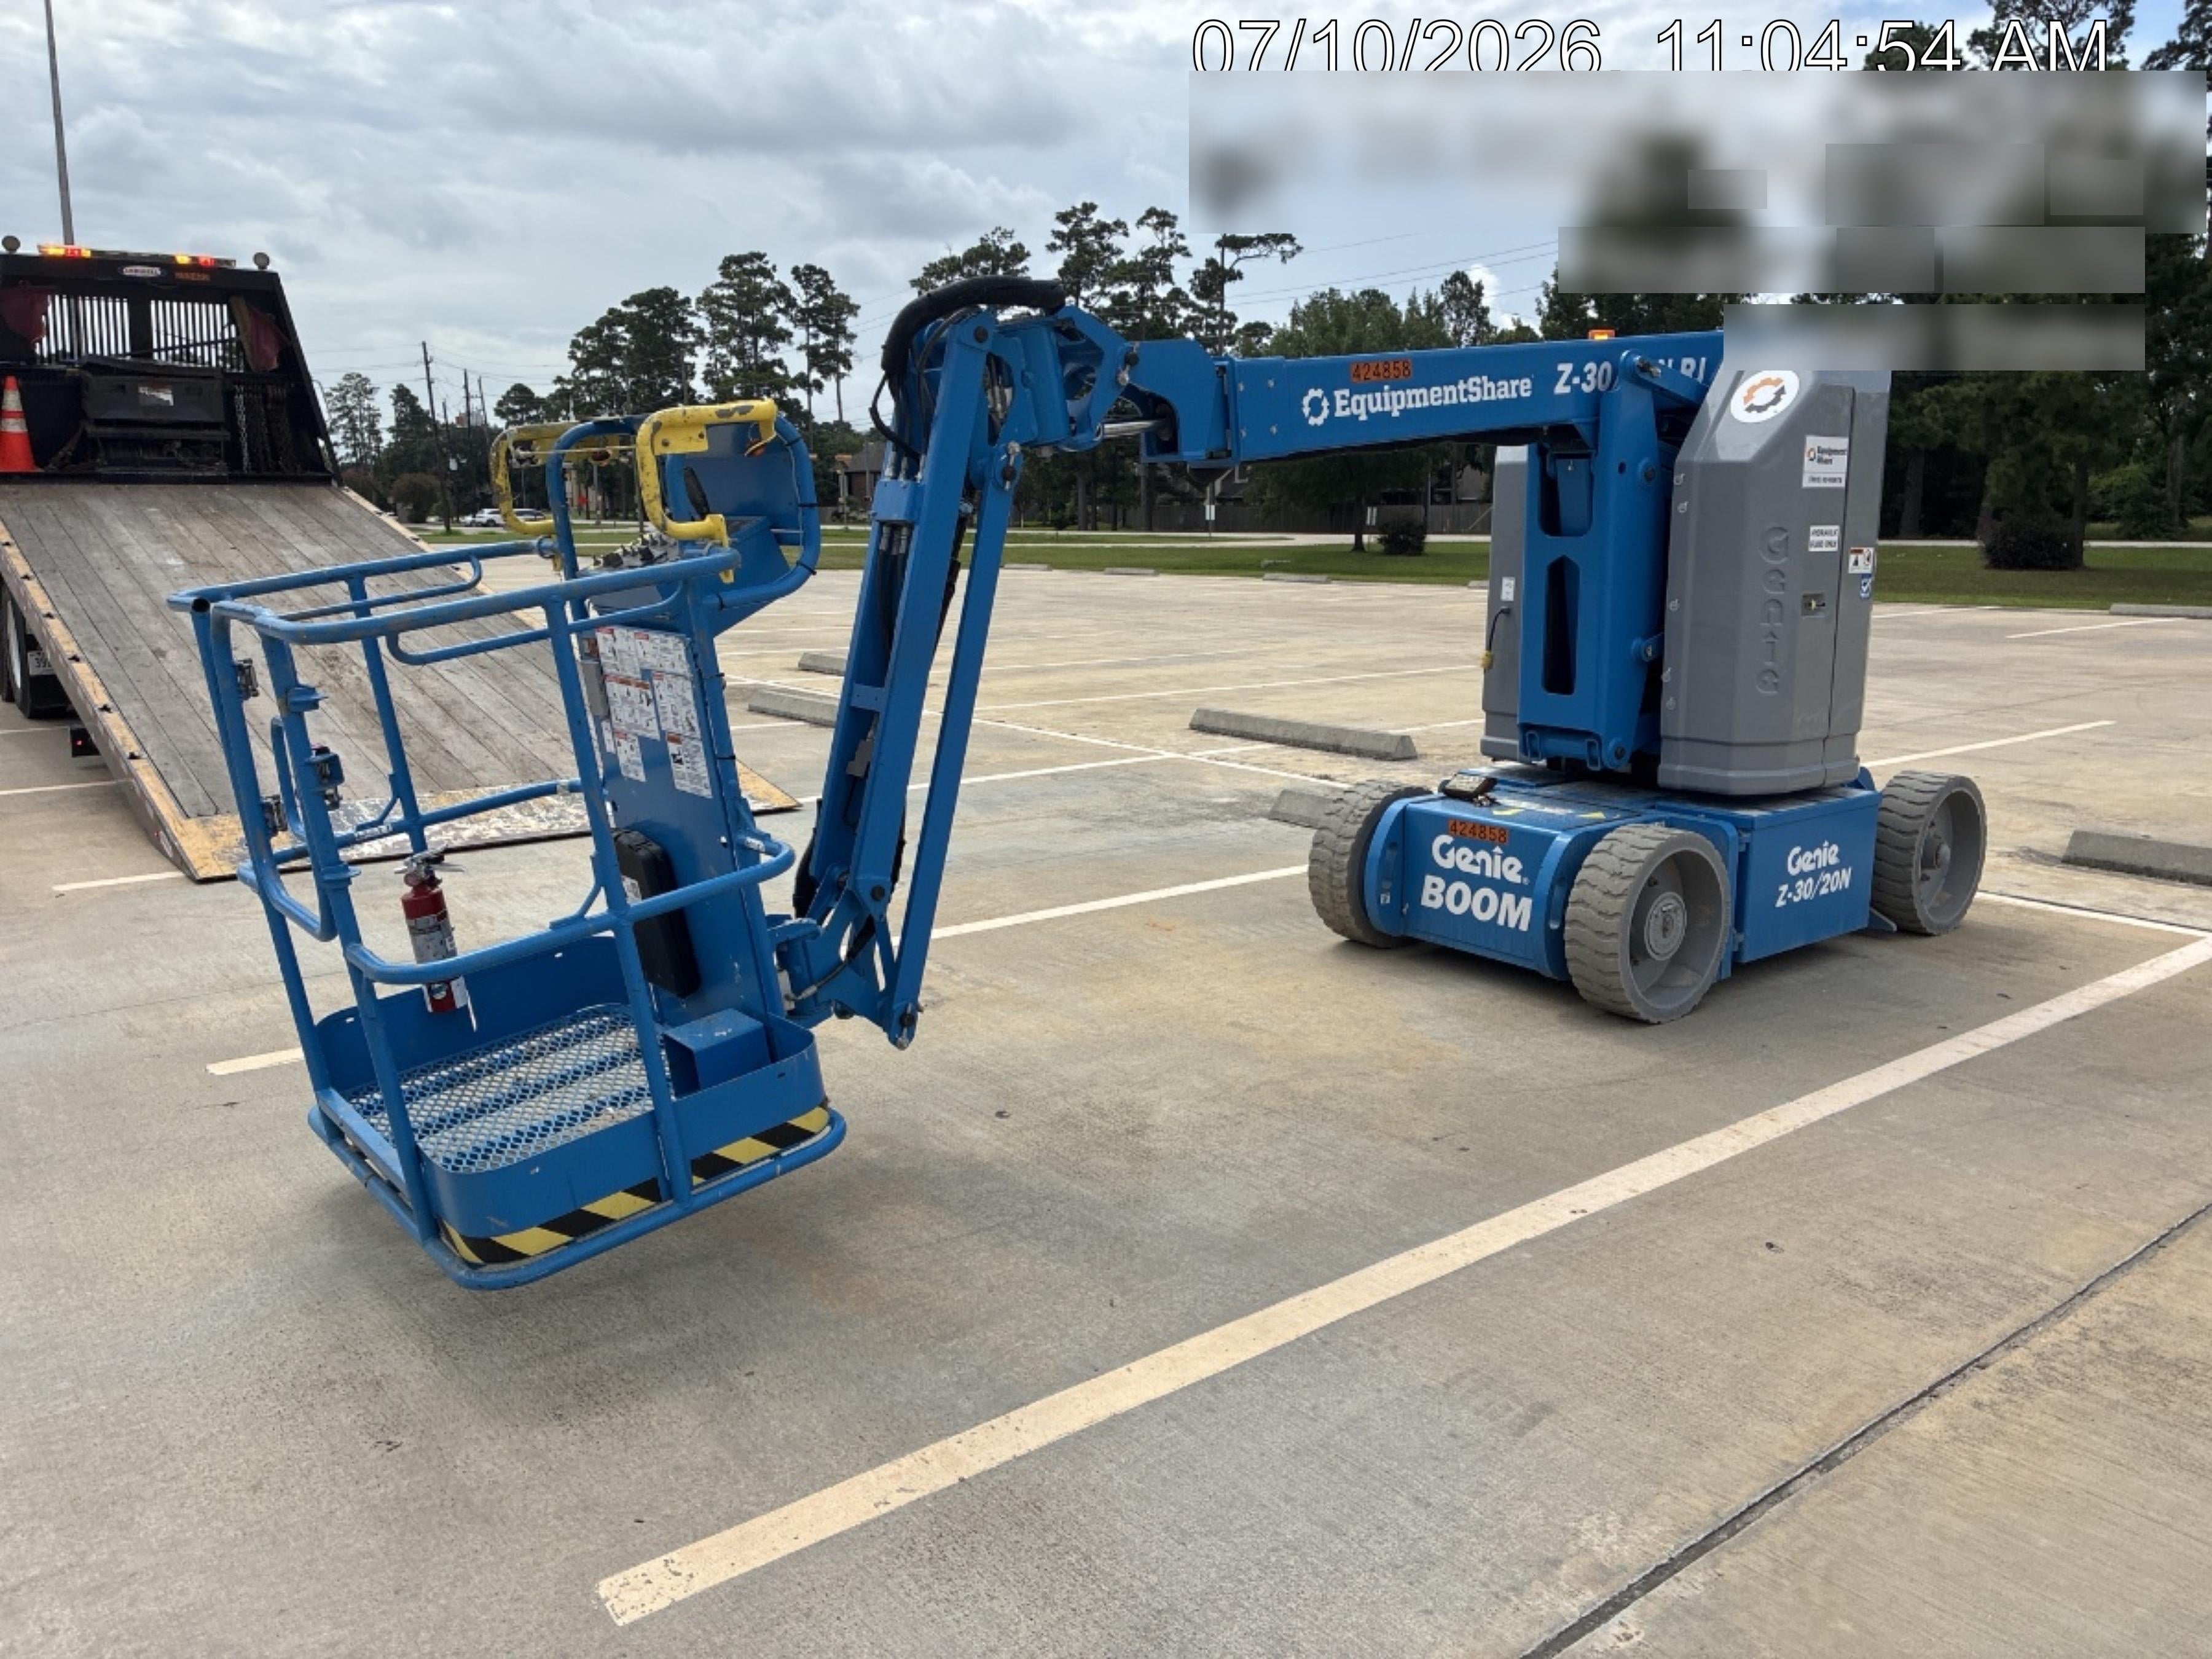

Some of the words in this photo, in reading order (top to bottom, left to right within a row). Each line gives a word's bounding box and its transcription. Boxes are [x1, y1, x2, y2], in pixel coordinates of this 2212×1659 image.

[1352, 359, 1411, 381] 424858
[1333, 375, 1532, 422] EquipmentShare
[1449, 820, 1507, 844] 424858
[1432, 834, 1524, 884] Genie
[1787, 839, 1840, 876] Genie
[1421, 874, 1533, 932] BOOM
[1775, 866, 1852, 908] Z-30/20N
